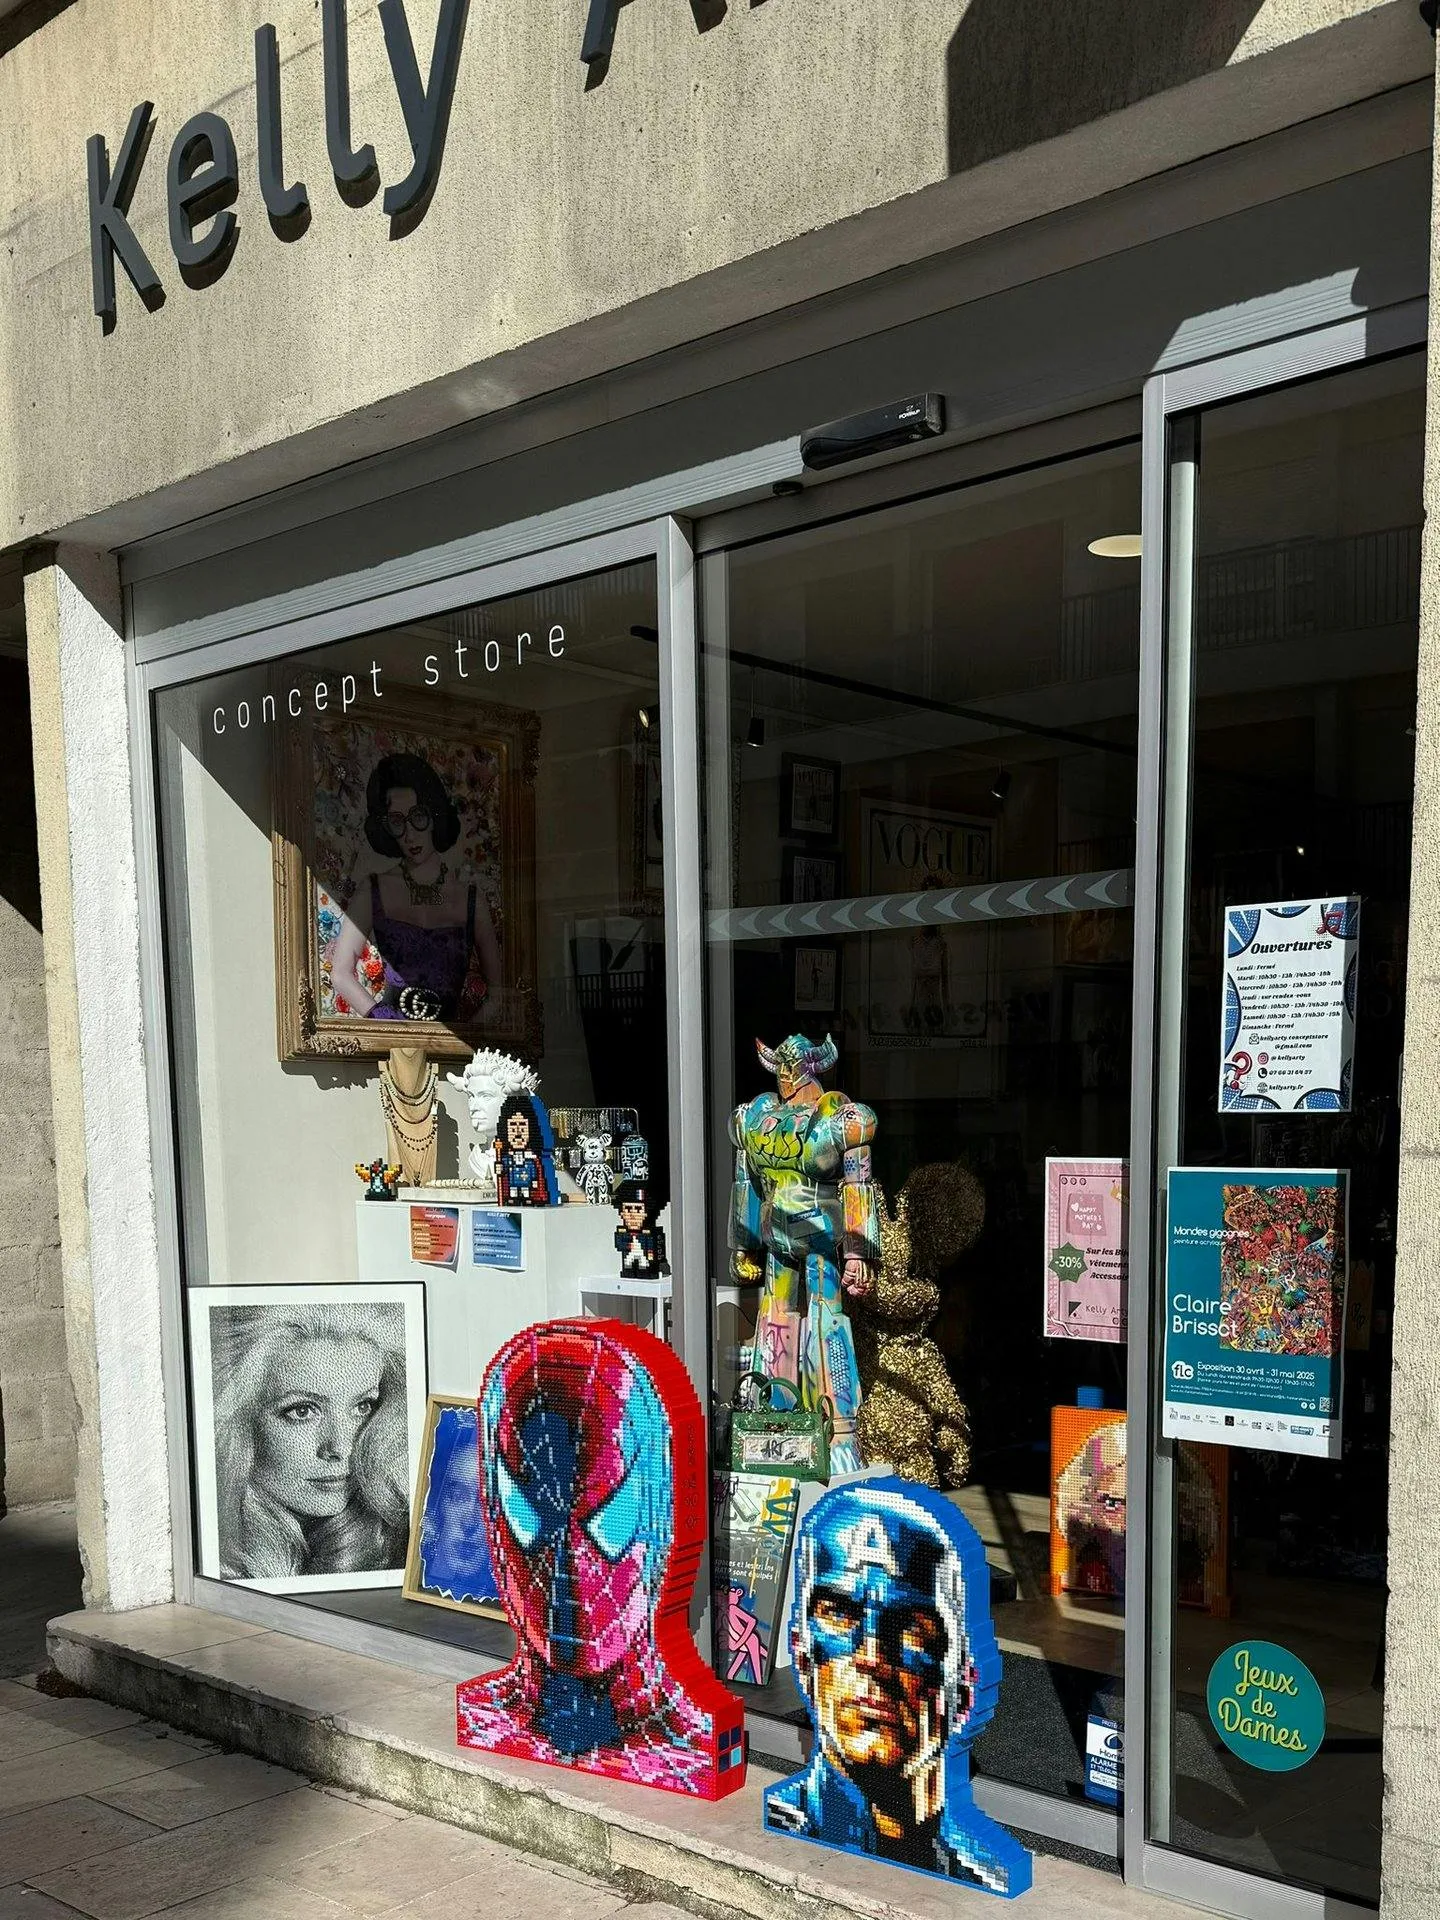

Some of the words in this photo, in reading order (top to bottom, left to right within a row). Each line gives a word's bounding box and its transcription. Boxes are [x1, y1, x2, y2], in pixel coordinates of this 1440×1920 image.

[86, 0, 470, 318] Kelly
[213, 661, 384, 735] concept
[424, 624, 565, 686] store
[876, 820, 987, 876] VOGUE
[1250, 939, 1332, 954] Ouvertures
[1173, 1226, 1208, 1237] Mondes
[1209, 1229, 1250, 1239] gigognes
[1086, 1247, 1101, 1255] Sur
[1102, 1248, 1114, 1256] les
[1054, 1256, 1082, 1269] -30%
[1086, 1305, 1107, 1315] Kelly
[1173, 1294, 1232, 1315] Claire
[1174, 1364, 1192, 1378] flc
[1197, 1361, 1235, 1374] Exposition
[1236, 1366, 1245, 1374] 30
[1246, 1367, 1264, 1376] avril
[1270, 1369, 1278, 1377] 31
[1279, 1370, 1295, 1378] mai
[1296, 1371, 1315, 1380] 2025
[748, 1570, 773, 1581] éuipés
[1235, 1650, 1298, 1696] Jeux
[1251, 1689, 1277, 1718] de
[1218, 1697, 1307, 1751] Dames
